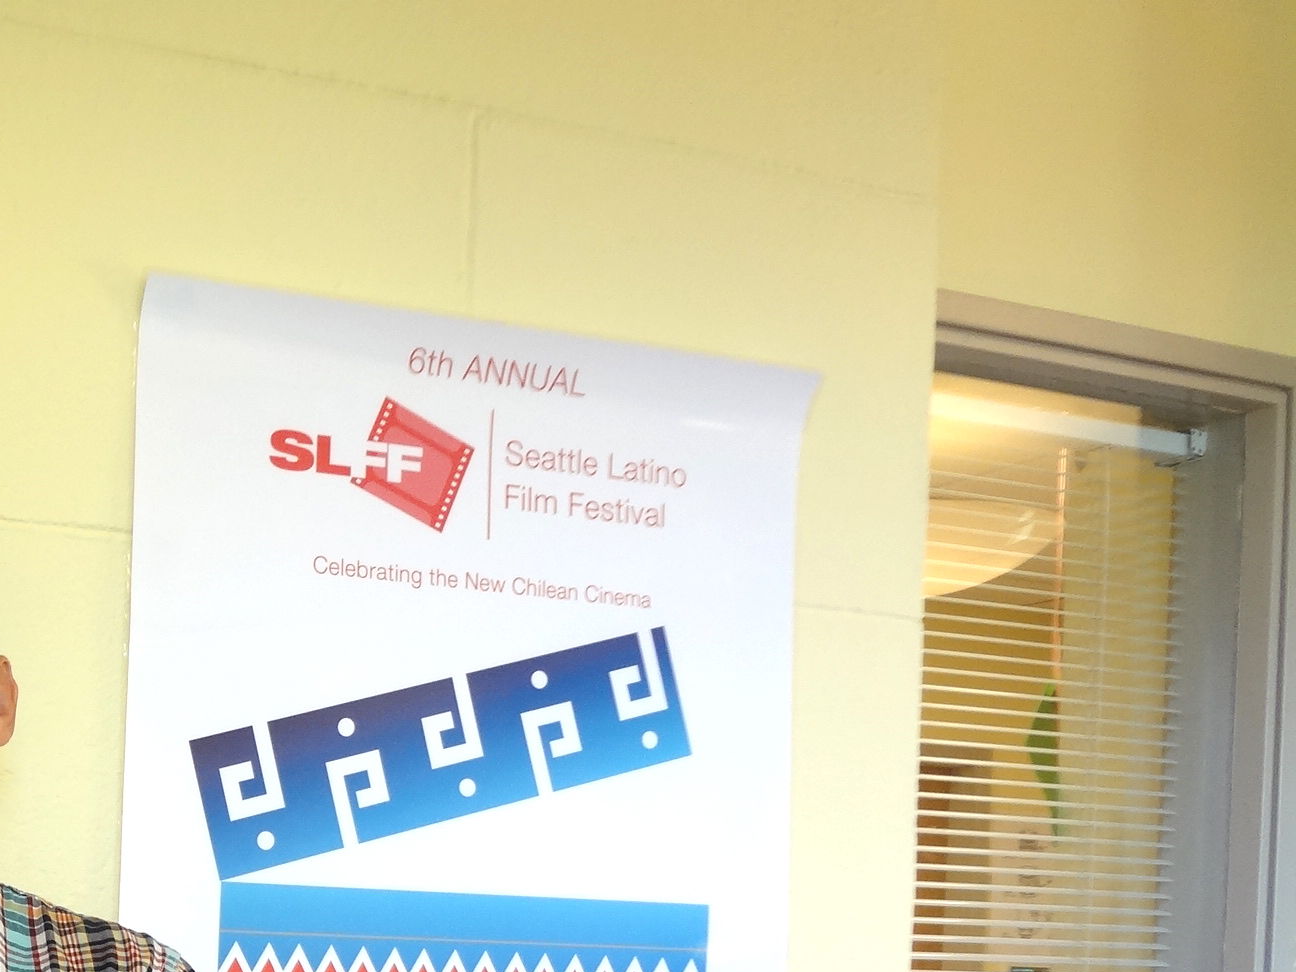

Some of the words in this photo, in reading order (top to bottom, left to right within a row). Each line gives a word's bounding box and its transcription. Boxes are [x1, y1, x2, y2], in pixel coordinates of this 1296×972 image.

[408, 346, 454, 379] 6th
[462, 354, 587, 398] ANNUAL
[269, 428, 424, 484] SLFF
[504, 439, 599, 476] Seattle
[608, 452, 688, 489] Latino
[504, 484, 559, 515] Film
[569, 491, 666, 529] Festival
[312, 555, 423, 590] Celebrating
[429, 568, 459, 588] the
[465, 572, 506, 594] New
[511, 577, 579, 601] Chilean
[585, 585, 653, 610] Cinema
